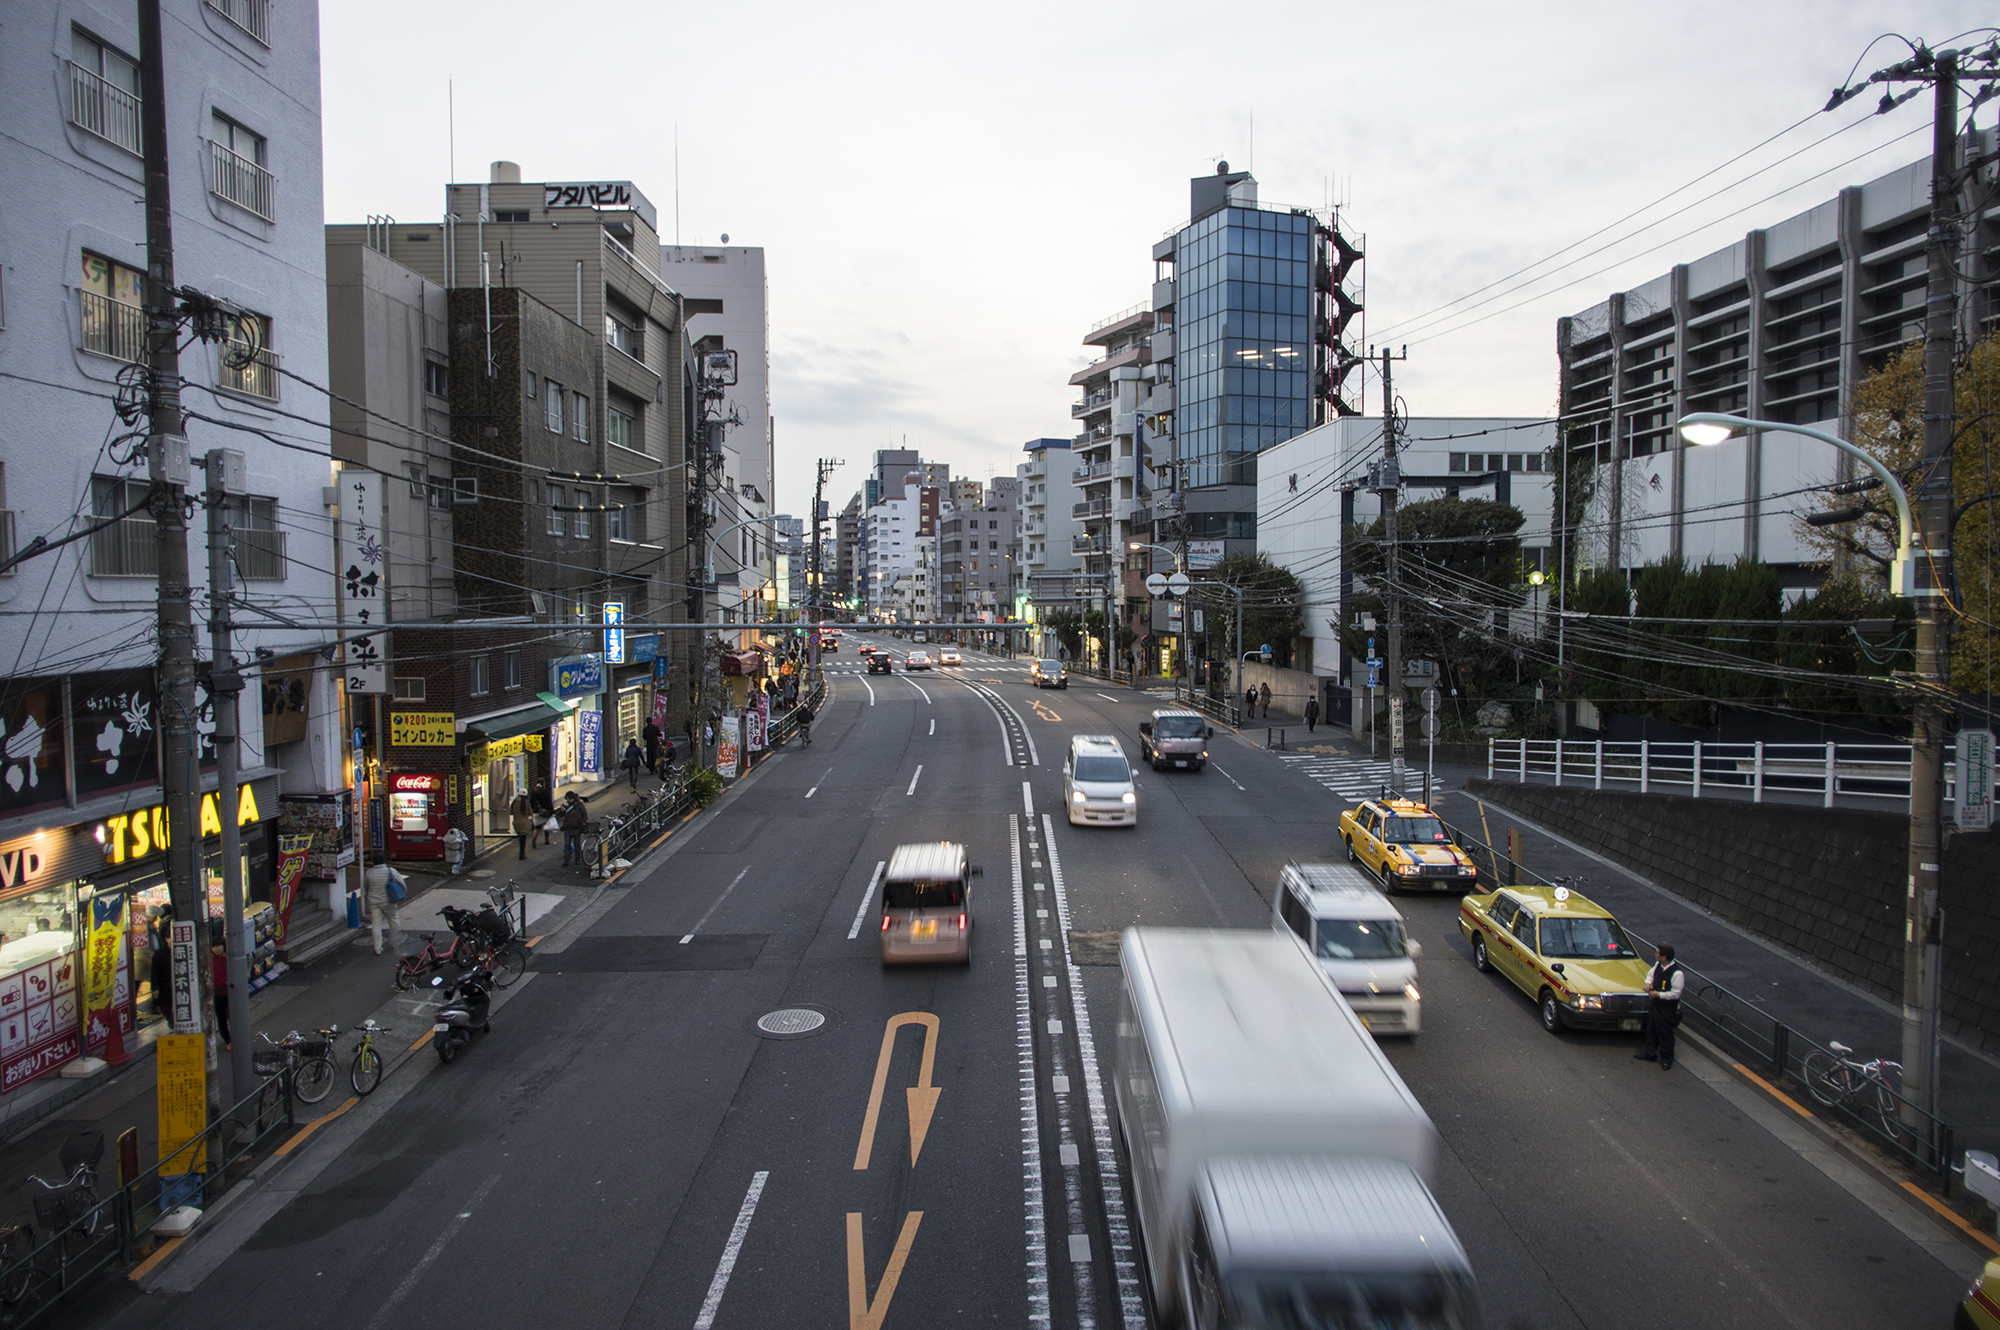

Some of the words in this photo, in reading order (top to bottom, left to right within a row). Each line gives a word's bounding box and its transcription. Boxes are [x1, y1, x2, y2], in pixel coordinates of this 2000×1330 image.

[545, 184, 631, 205] フタバビル
[997, 481, 1016, 491] NOA
[350, 677, 366, 690] 2F
[570, 666, 600, 685] クリーニング
[404, 714, 426, 726] ¥200
[394, 729, 453, 743] コインロッカー
[489, 740, 522, 758] コインロッカー
[396, 775, 433, 789] Coca-Cola
[107, 784, 259, 864] TSUAA
[5, 1037, 77, 1084] お売り下さい
